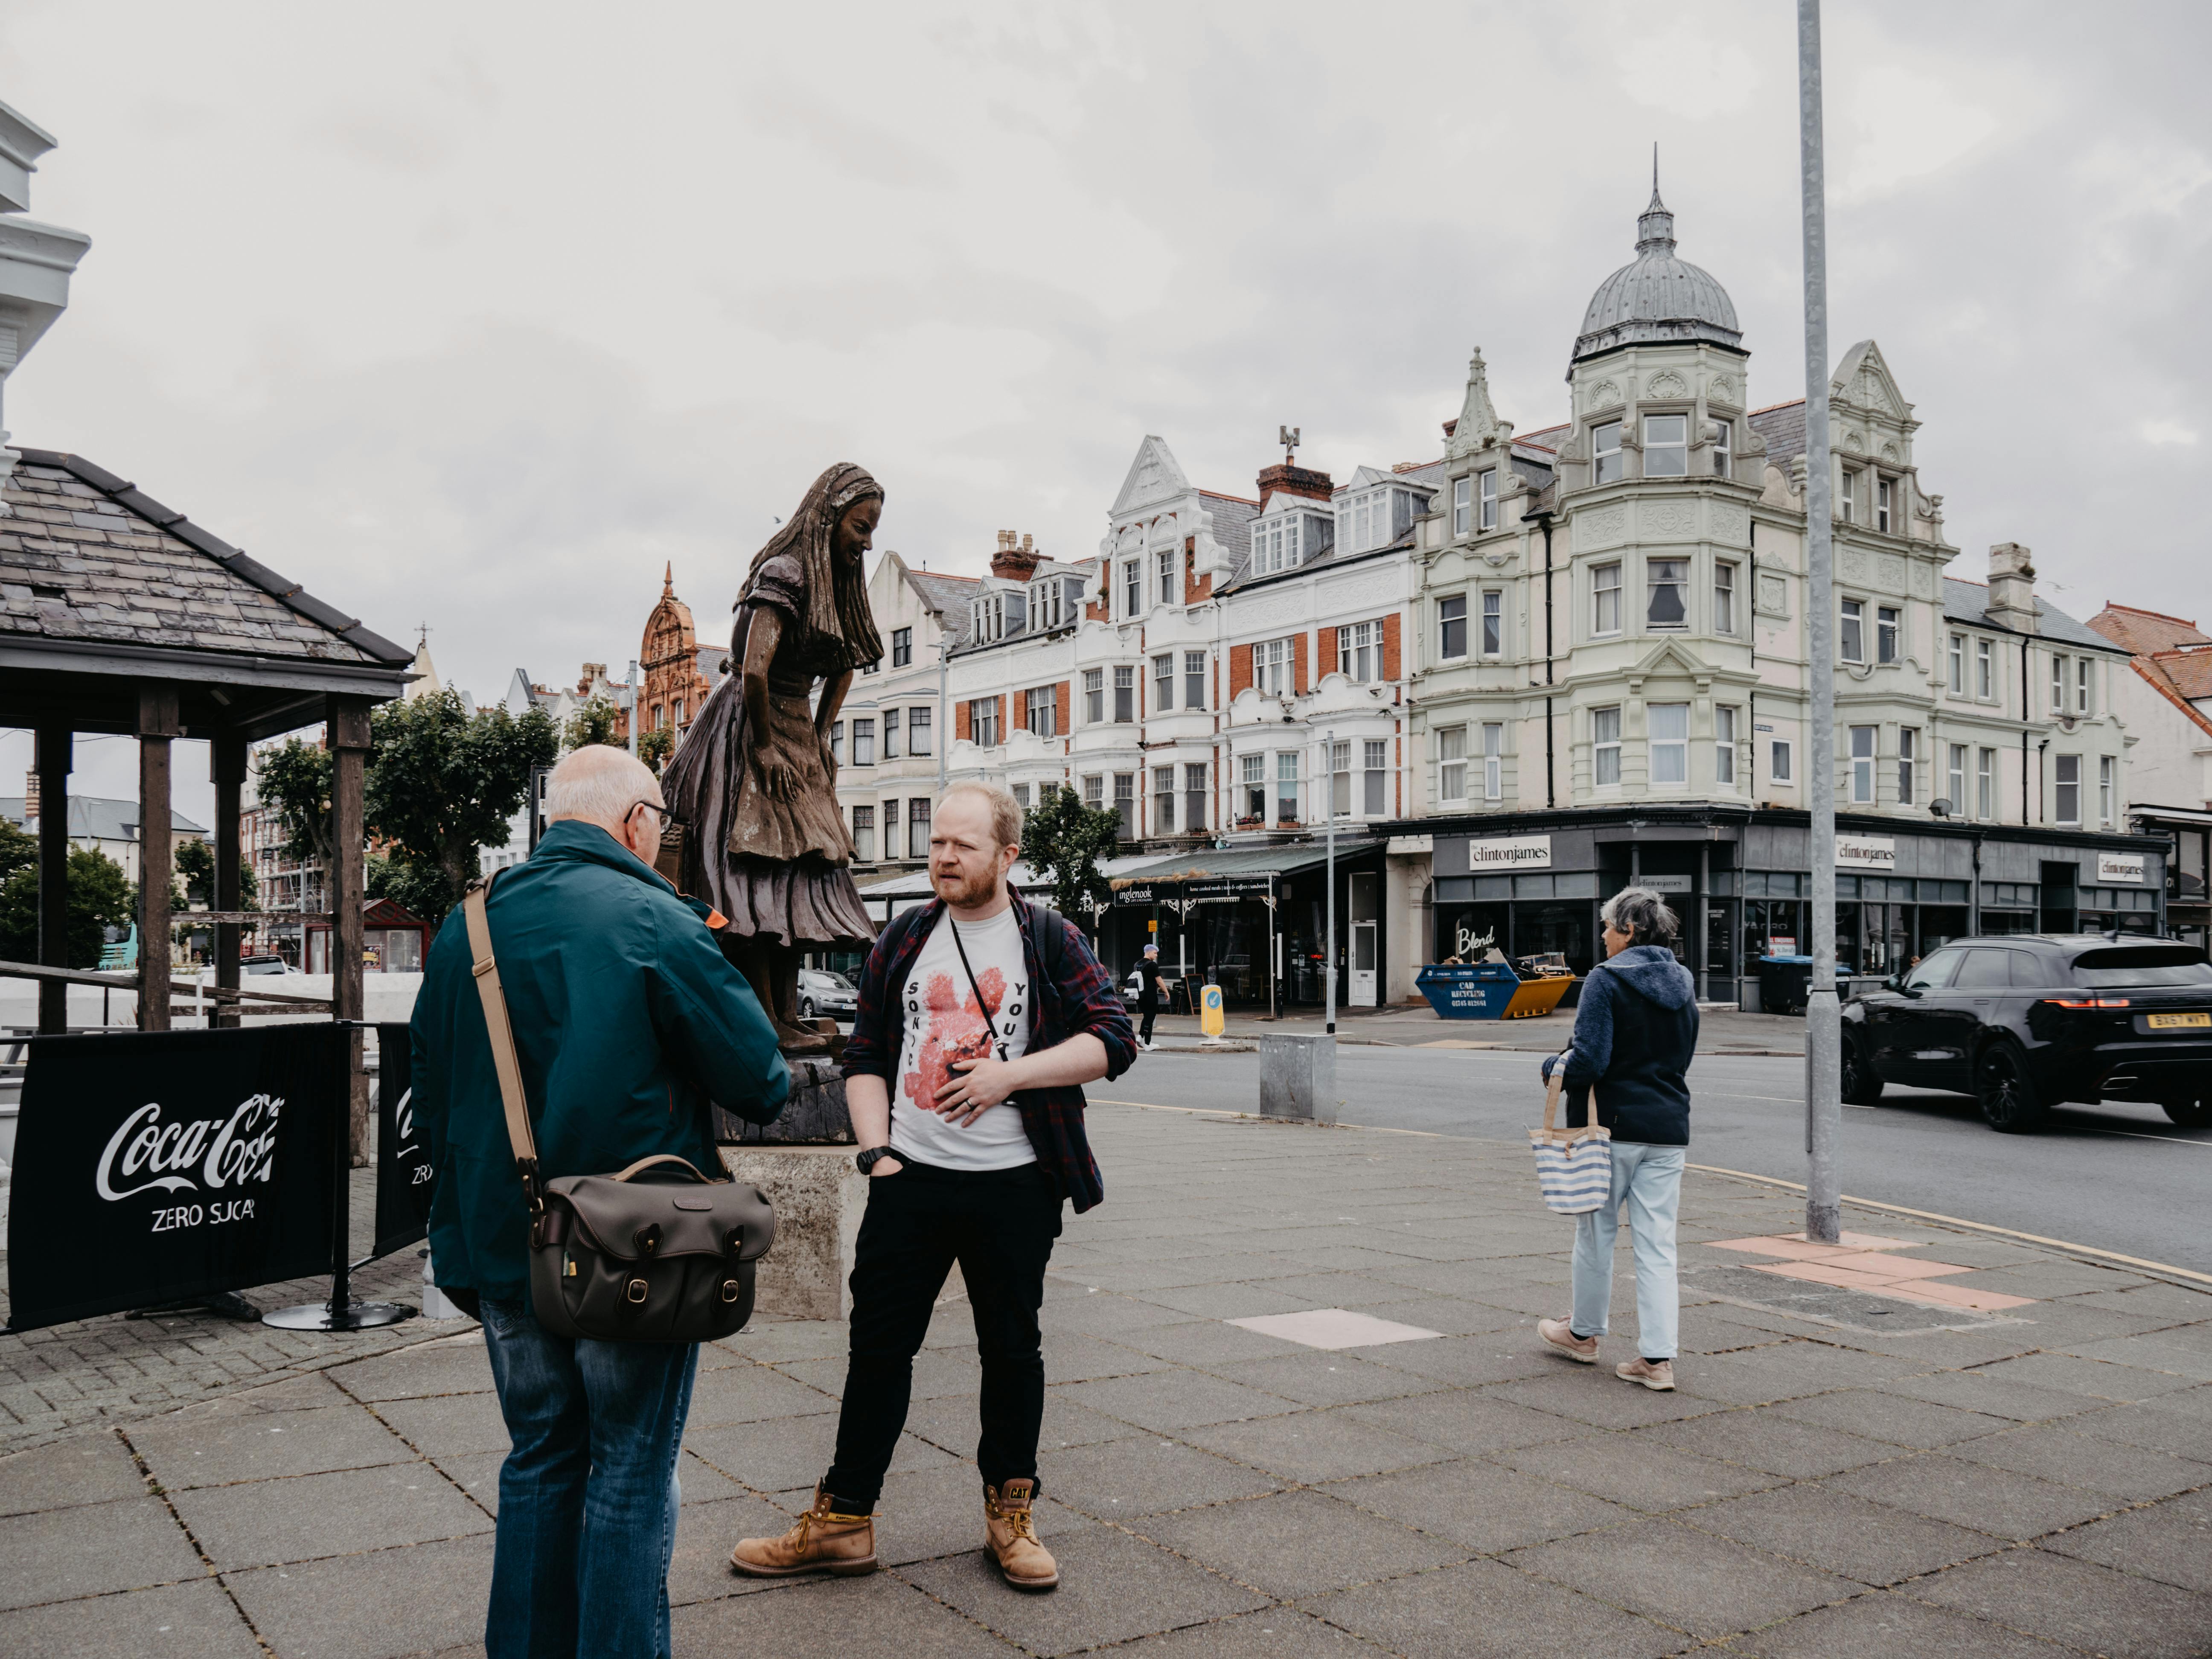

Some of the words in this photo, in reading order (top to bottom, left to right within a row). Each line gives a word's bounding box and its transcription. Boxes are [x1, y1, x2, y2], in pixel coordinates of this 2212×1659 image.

[1474, 845, 1548, 863] clintonjames
[1839, 843, 1895, 863] clintonjames
[1119, 885, 1152, 903] inglenook
[1457, 926, 1495, 955] Blend
[908, 981, 920, 1066] SONIC
[151, 1204, 203, 1232] ZERO
[1010, 1488, 1028, 1499] CAT
